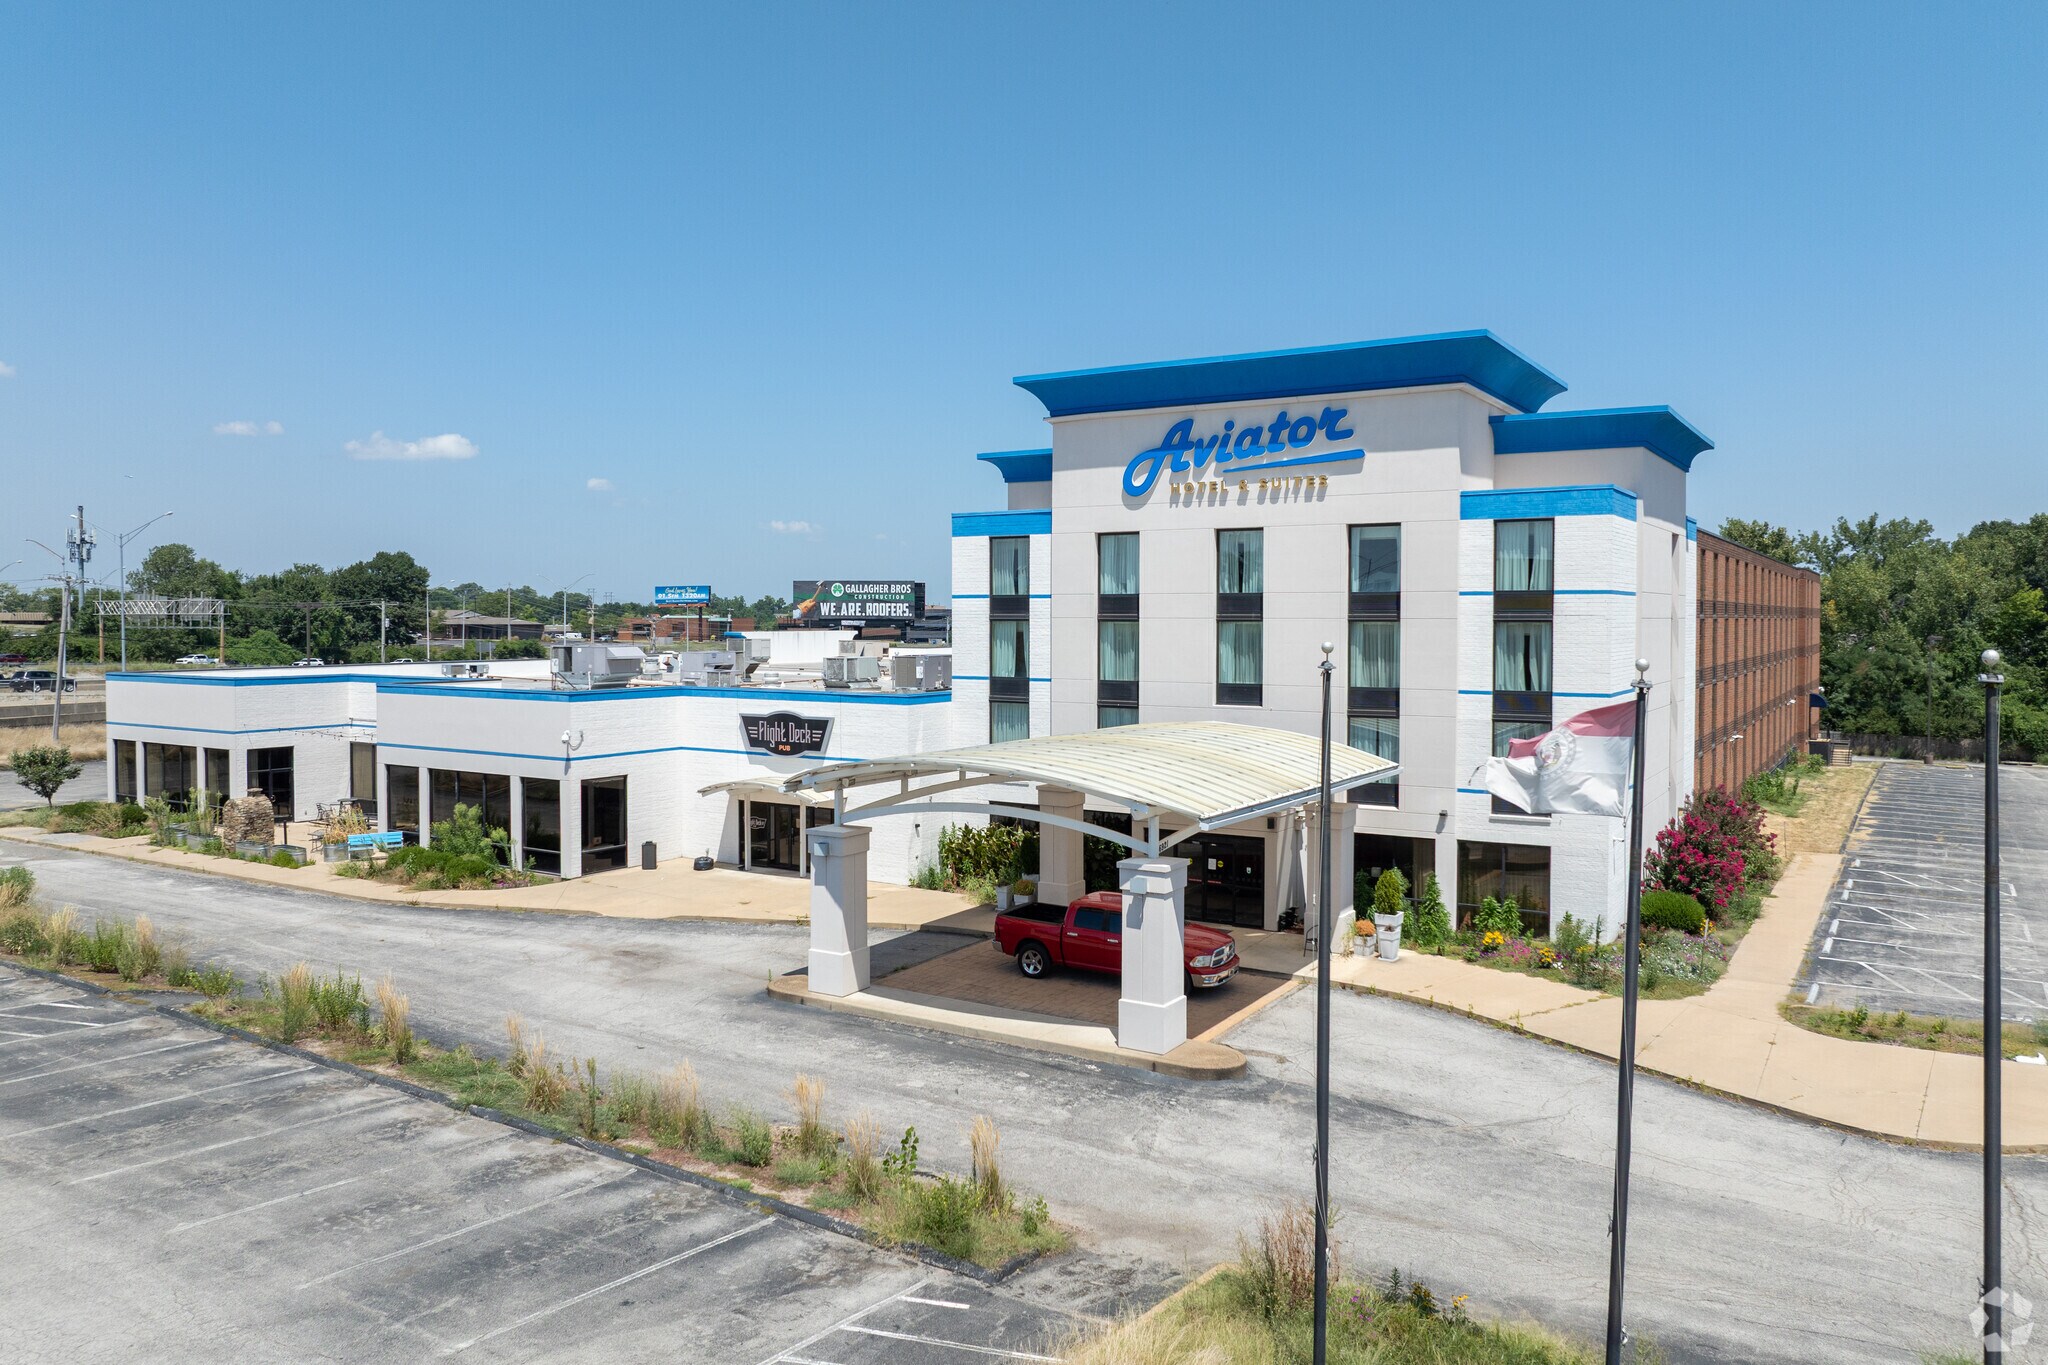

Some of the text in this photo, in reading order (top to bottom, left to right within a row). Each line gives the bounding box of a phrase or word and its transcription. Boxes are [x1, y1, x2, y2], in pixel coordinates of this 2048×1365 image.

[1122, 406, 1354, 497] Aviator
[1170, 475, 1329, 495] HOTEL & SUITES
[845, 584, 912, 594] GALLAGHER BROS
[759, 721, 811, 747] Flight Deck
